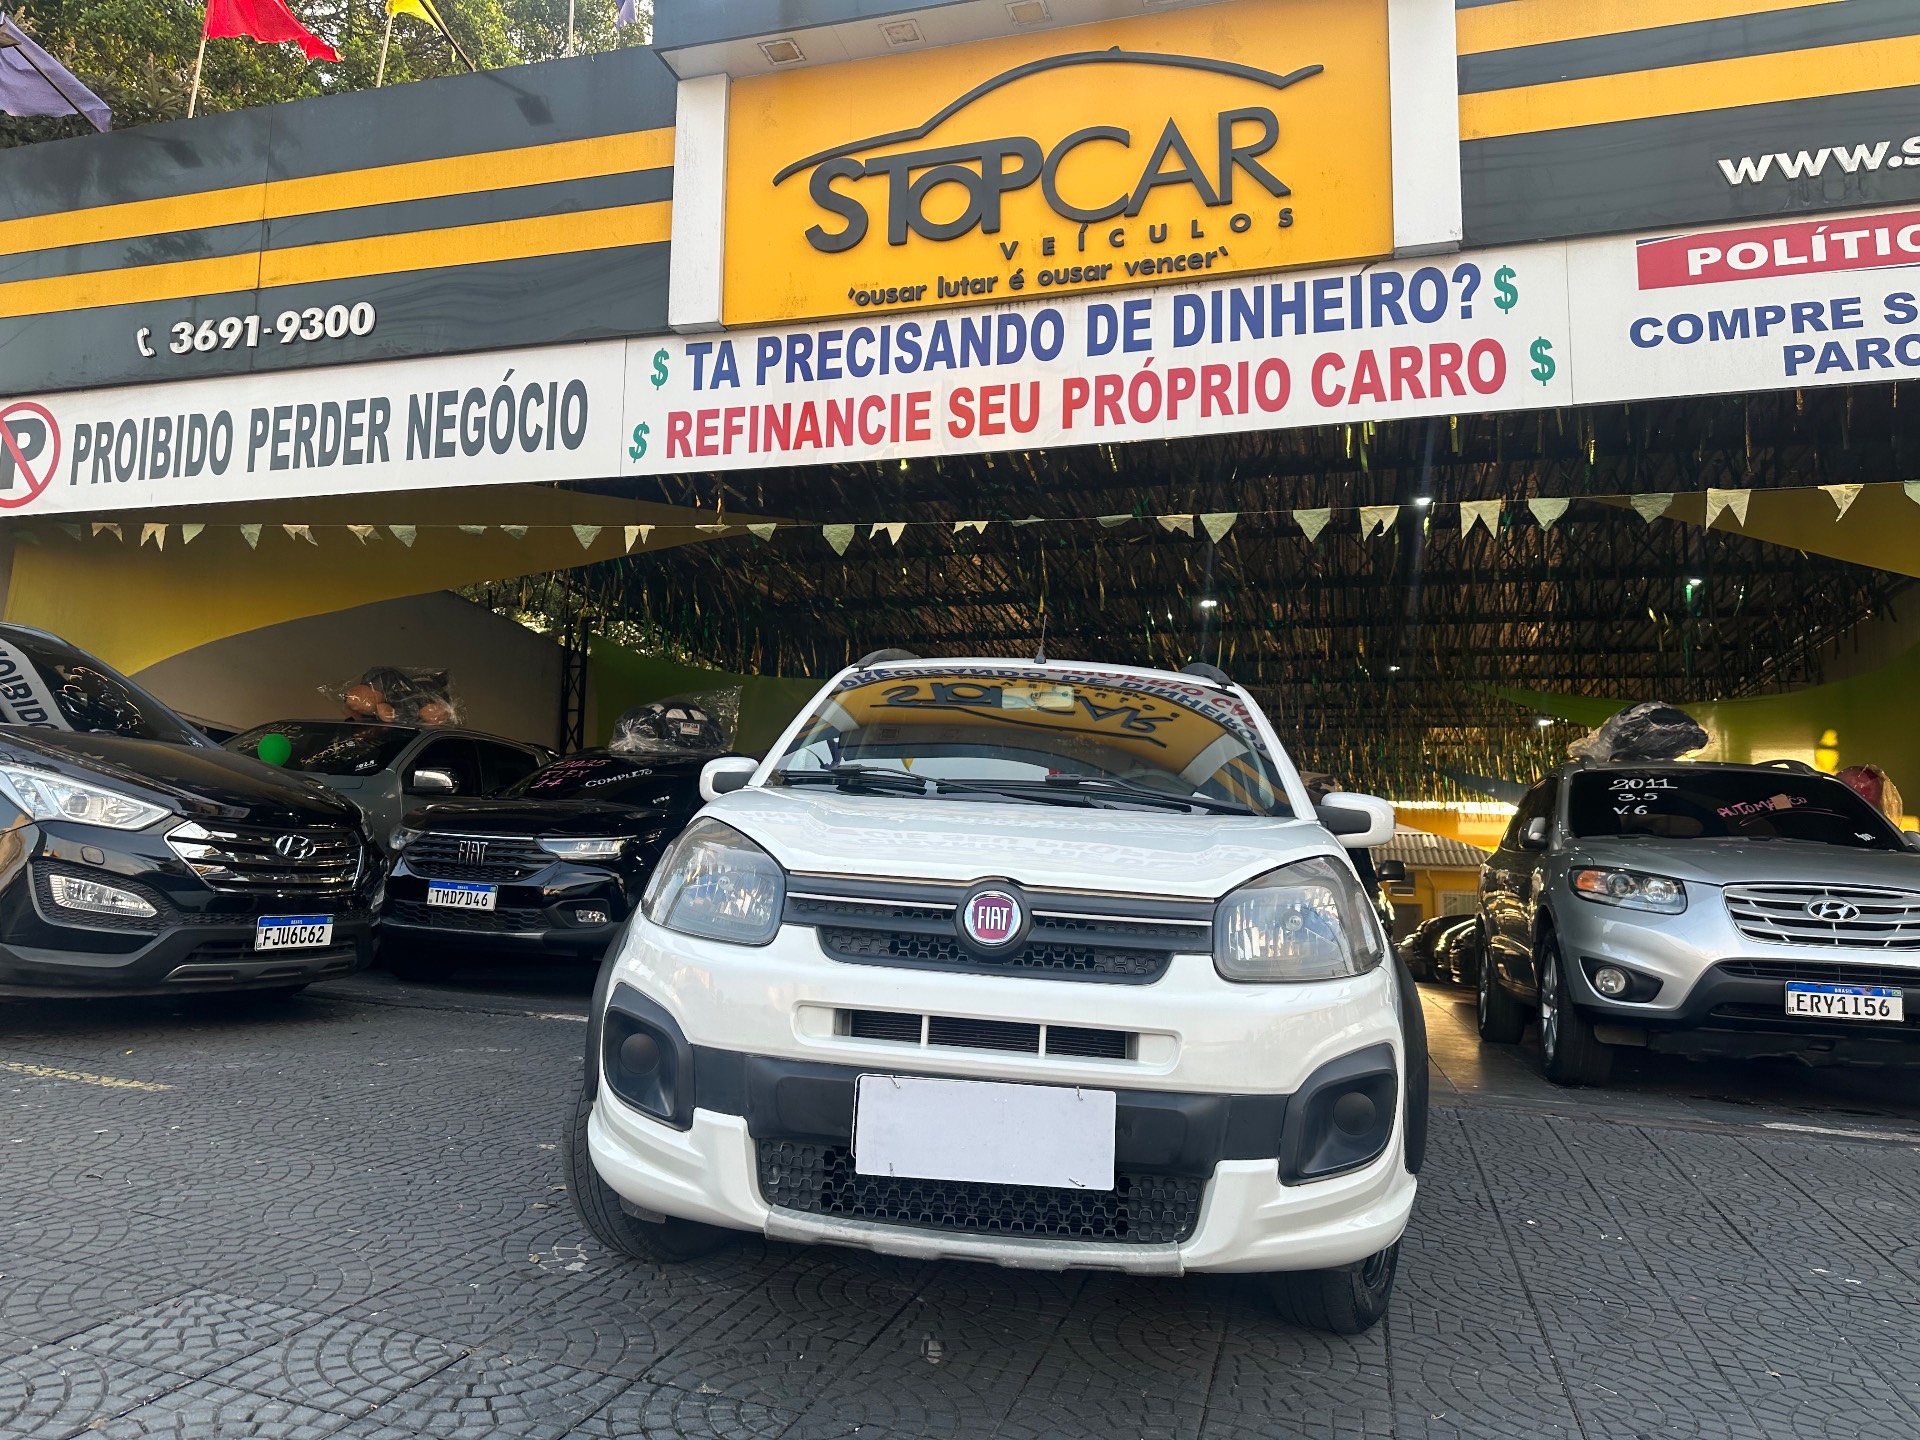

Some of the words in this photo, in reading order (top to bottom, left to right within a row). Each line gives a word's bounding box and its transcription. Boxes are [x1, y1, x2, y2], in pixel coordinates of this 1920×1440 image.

[999, 207, 1294, 261] VEÍCULOS
[937, 275, 998, 300] lutar
[1008, 267, 1025, 290] é
[1037, 261, 1113, 287] ousar
[169, 301, 376, 355] 3691-9300
[686, 339, 741, 391] TA
[757, 309, 1065, 386] PRECISANDO
[1087, 299, 1153, 357] DE
[1173, 262, 1482, 348] DINHEIRO?
[1629, 297, 1864, 349] COMPRE
[666, 391, 932, 459] REFINANCIE
[947, 381, 1041, 439] SEU
[1062, 357, 1291, 430] PRÓPRIO
[1311, 338, 1507, 408] CARRO
[69, 398, 234, 486] PROIBIDO
[247, 392, 391, 473] PERDER
[406, 369, 588, 461] NEGÓCIO
[585, 768, 653, 788] COMPLETO
[1608, 778, 1678, 790] 2011
[1617, 792, 1658, 802] 3.5
[459, 840, 489, 866] FIAT
[434, 889, 488, 907] TMD7D46
[977, 905, 1010, 931] FIAT
[262, 925, 325, 946] FJU6C62
